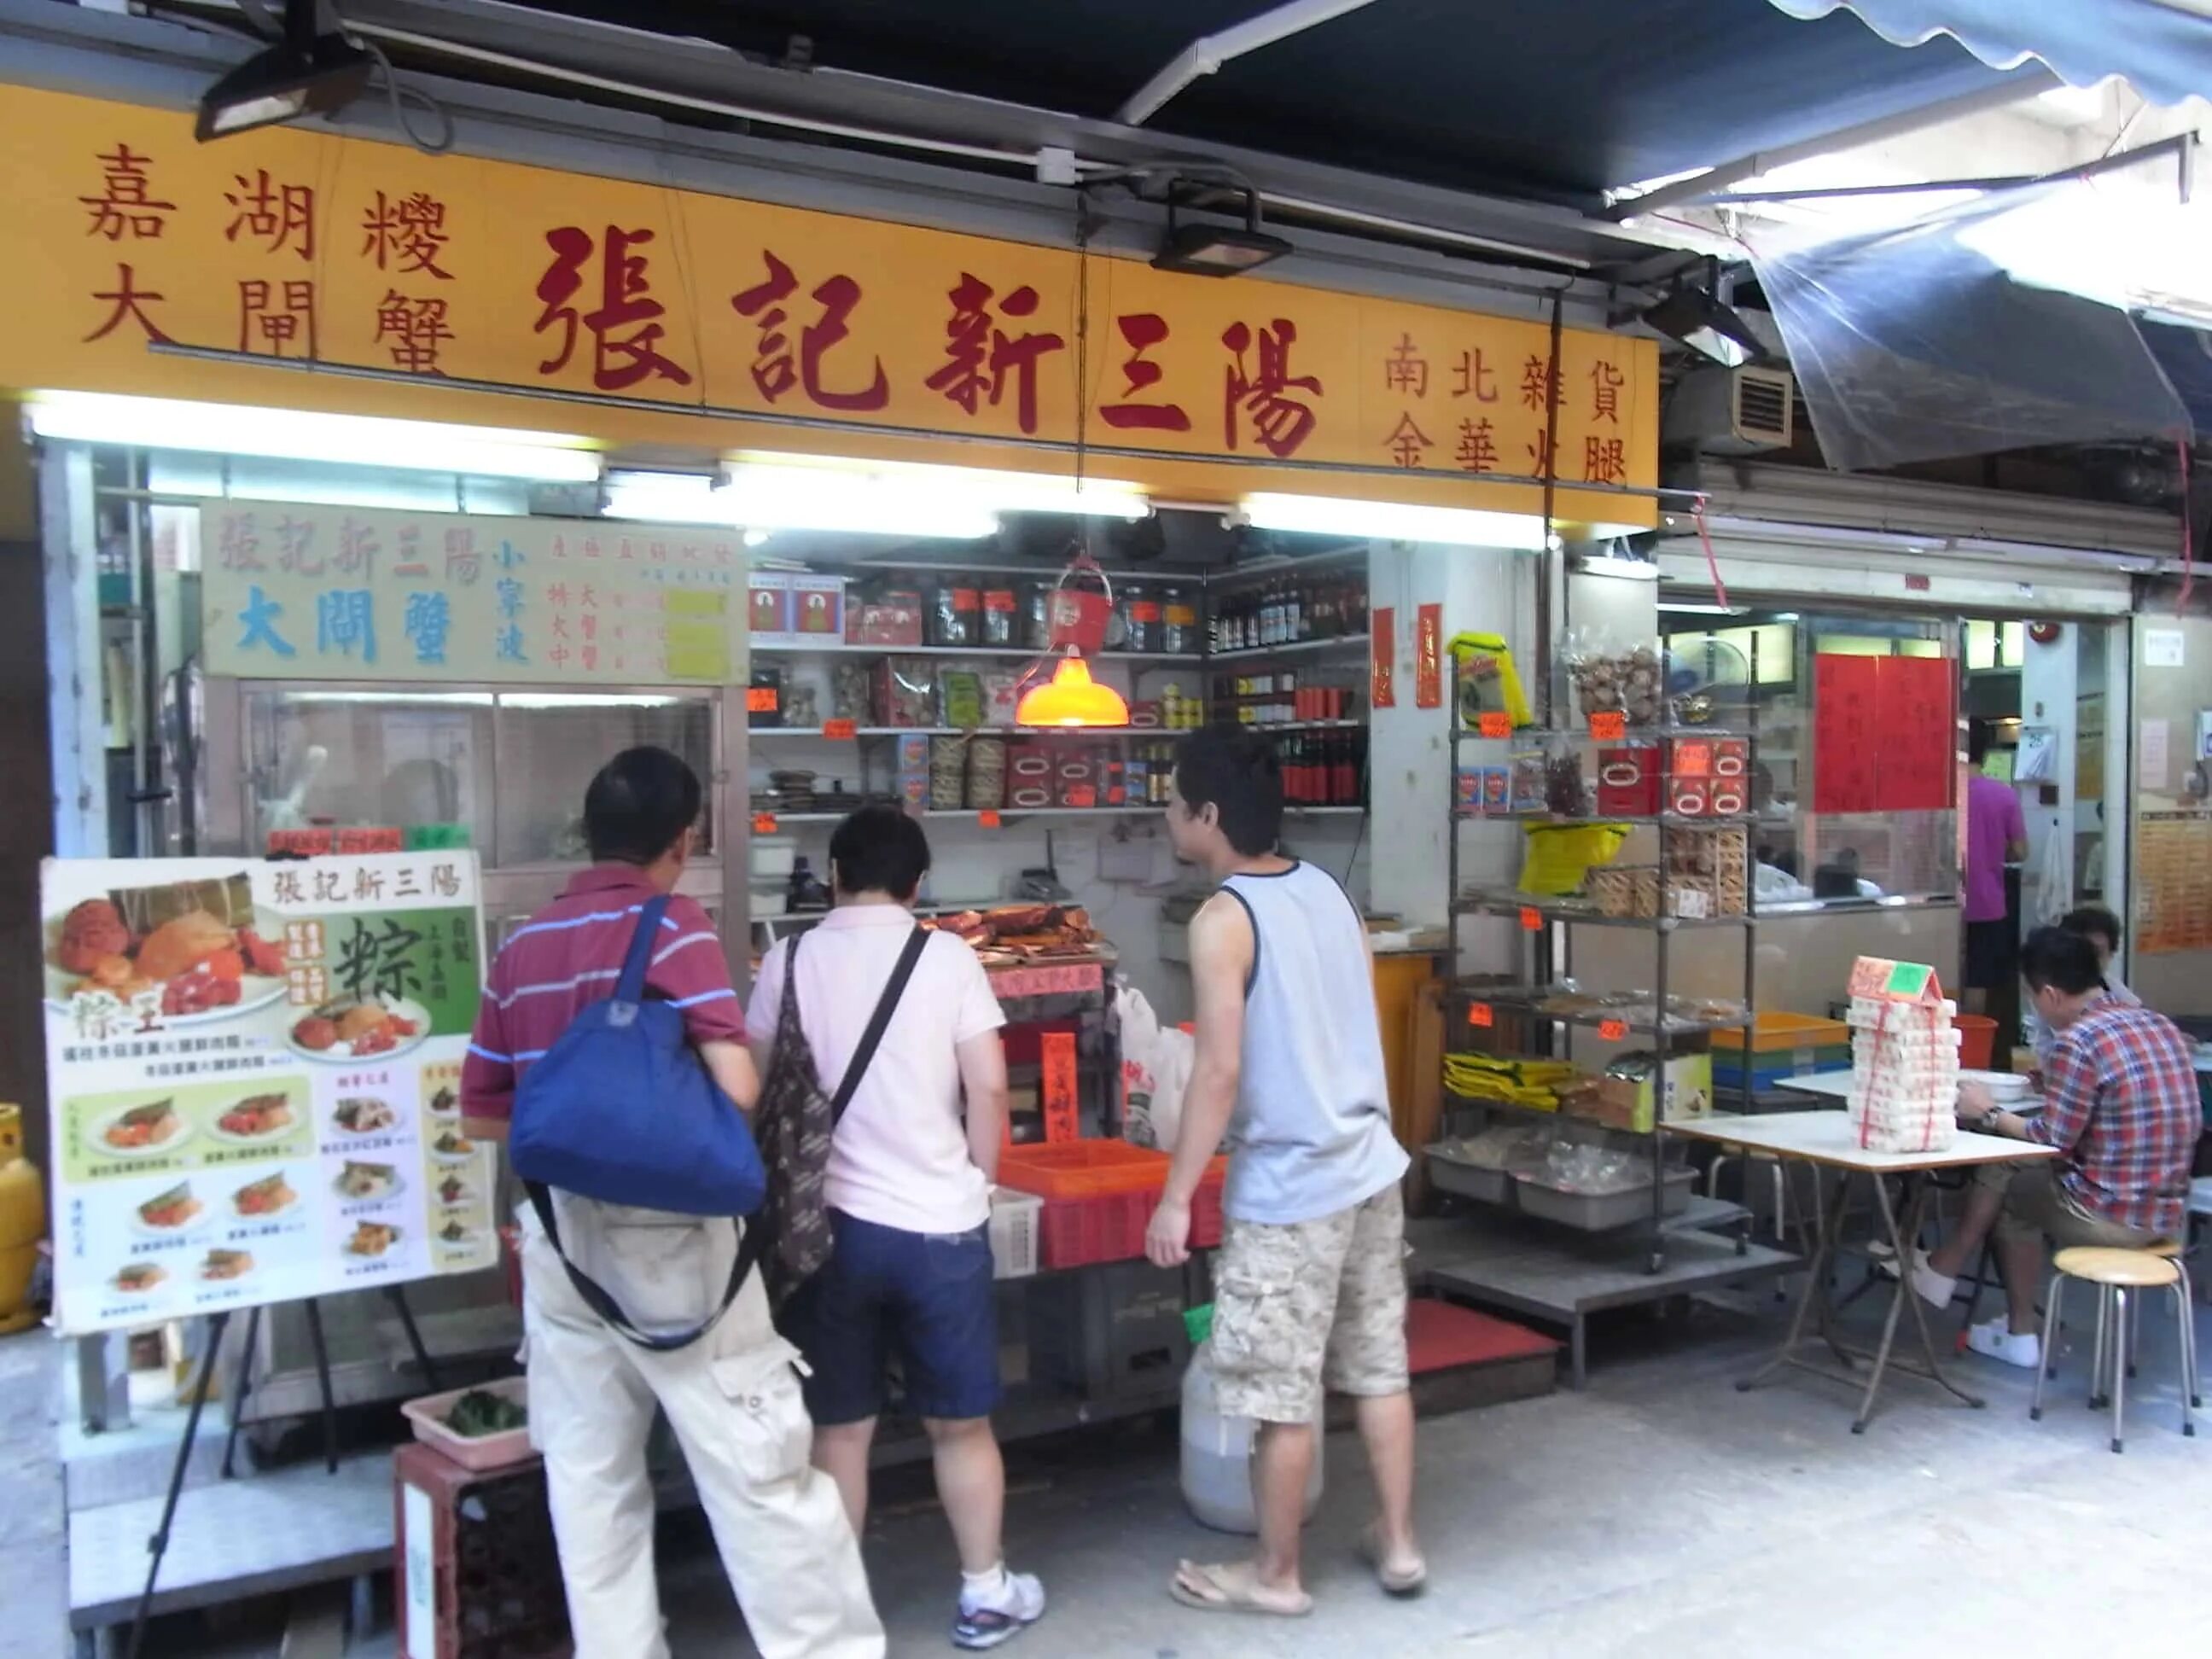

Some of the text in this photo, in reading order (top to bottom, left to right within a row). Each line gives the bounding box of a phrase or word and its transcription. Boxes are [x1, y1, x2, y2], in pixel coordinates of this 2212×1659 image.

[81, 262, 456, 377] 大閘蟹
[533, 224, 1324, 458] 張記新三陽
[1384, 332, 1625, 424] 南北雜貨
[1382, 410, 1627, 486] 金華火腿
[218, 513, 484, 586] 張記新三陽
[236, 584, 451, 666] 大閘蟹
[274, 864, 462, 904] 張記新三陽
[333, 916, 422, 1004] 粽
